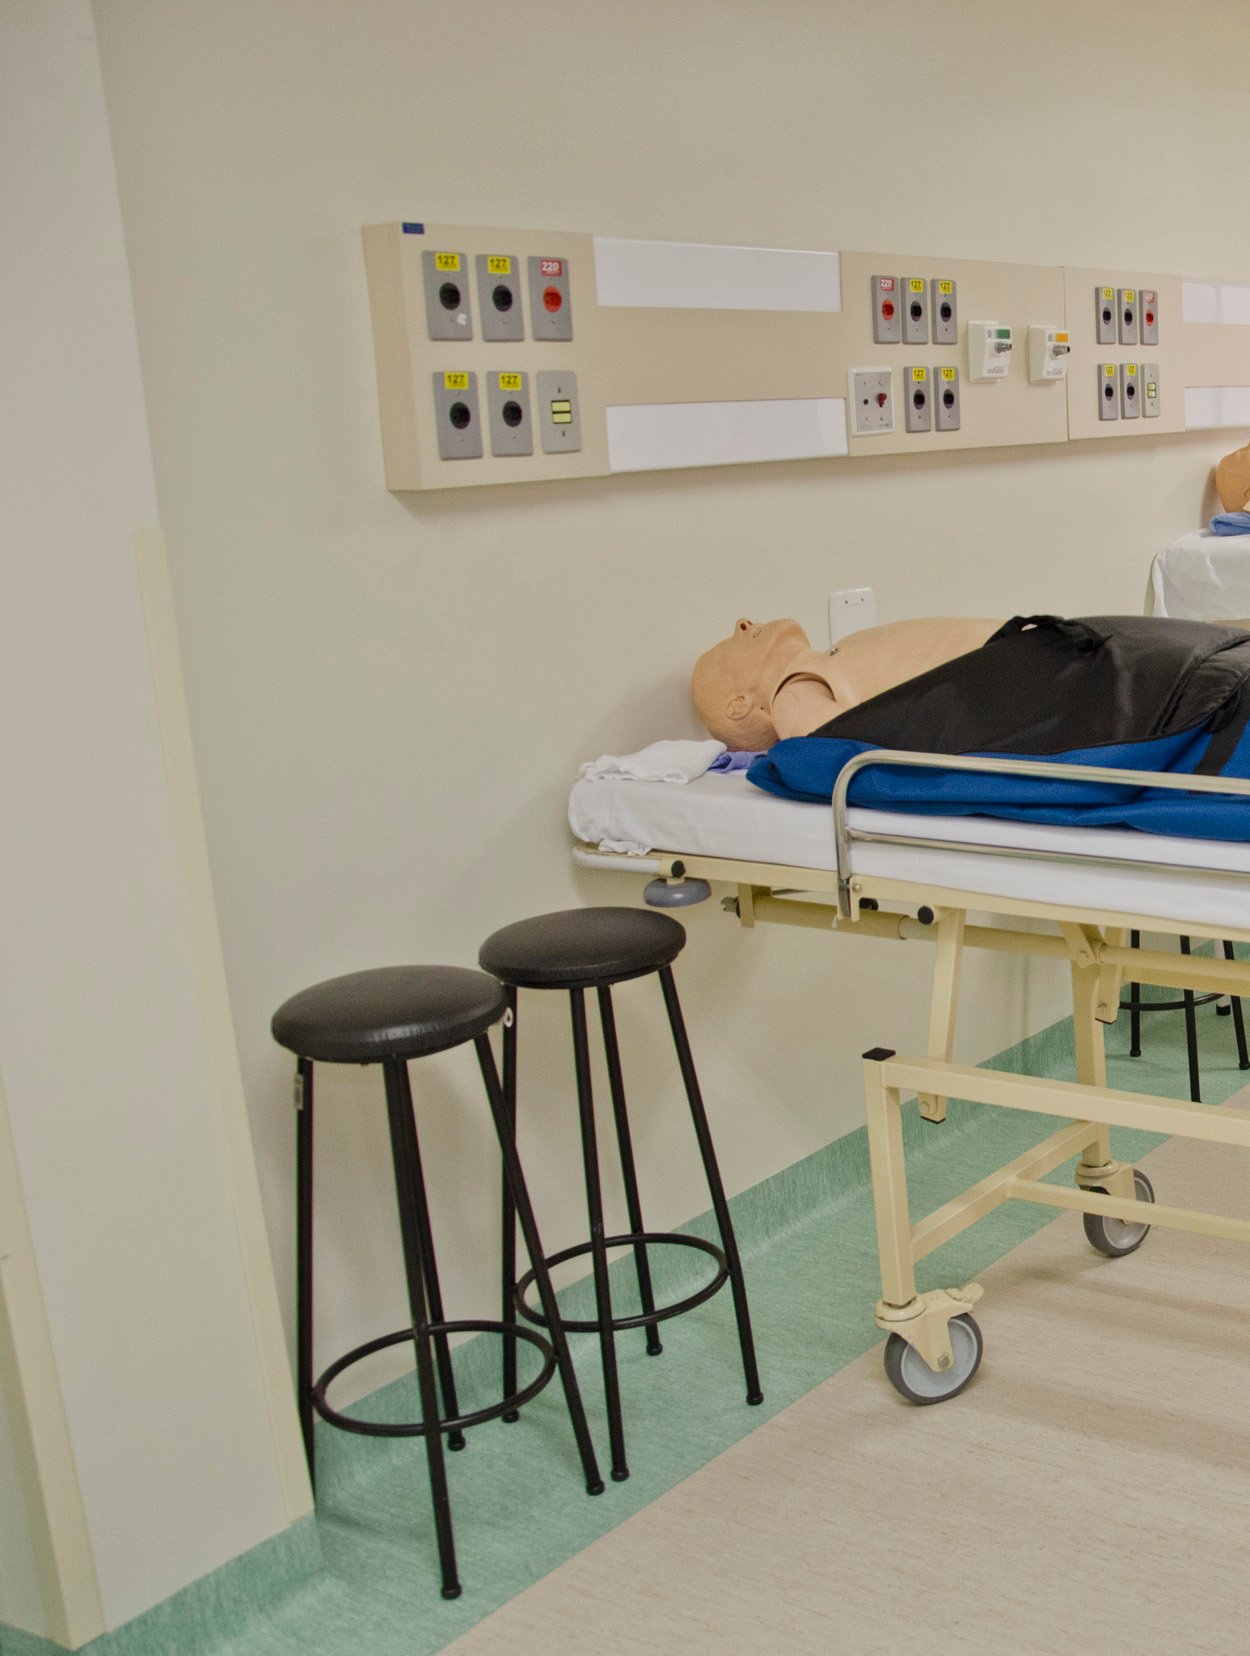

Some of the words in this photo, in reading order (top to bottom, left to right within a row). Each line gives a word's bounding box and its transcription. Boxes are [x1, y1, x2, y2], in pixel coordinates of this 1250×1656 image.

[437, 255, 456, 265] 127
[489, 258, 507, 268] 127
[541, 261, 559, 271] 220
[880, 278, 892, 287] 220
[911, 280, 921, 288] 127
[913, 369, 924, 377] 127
[447, 374, 465, 384] 127
[500, 375, 518, 385] 127
